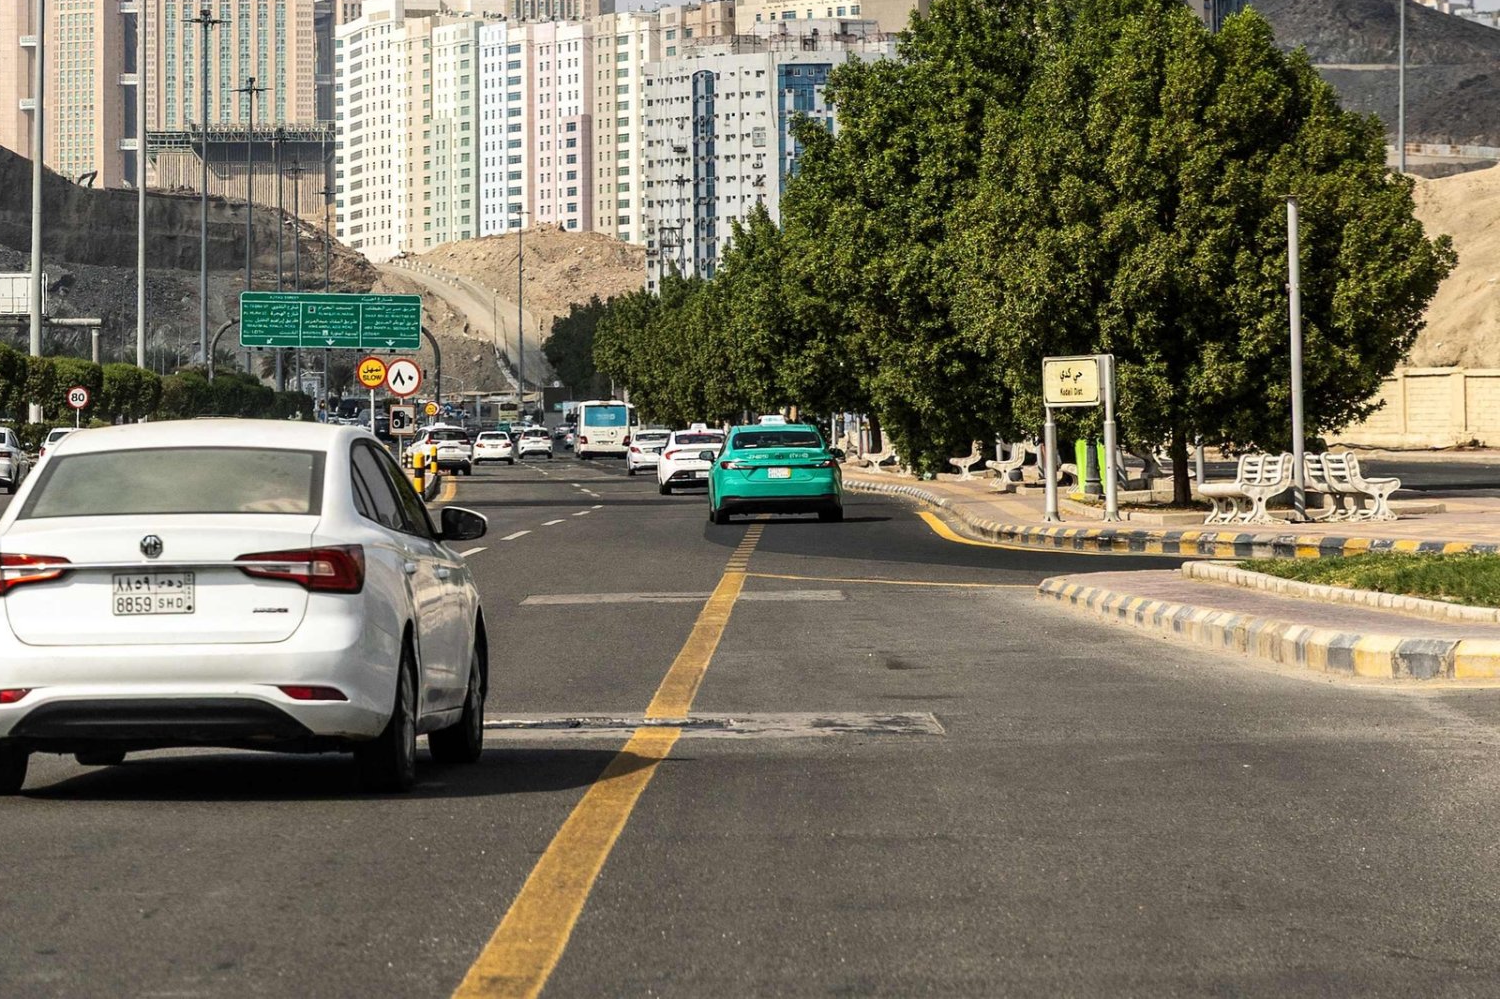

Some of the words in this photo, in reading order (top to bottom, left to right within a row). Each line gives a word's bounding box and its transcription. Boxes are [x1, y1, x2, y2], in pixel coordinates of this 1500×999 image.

[363, 365, 381, 374] تمهل
[392, 369, 414, 386] ٨٠
[1073, 371, 1083, 384] حي
[71, 392, 85, 402] 80
[116, 576, 151, 592] ٨٨٥٩
[116, 596, 152, 613] 8859
